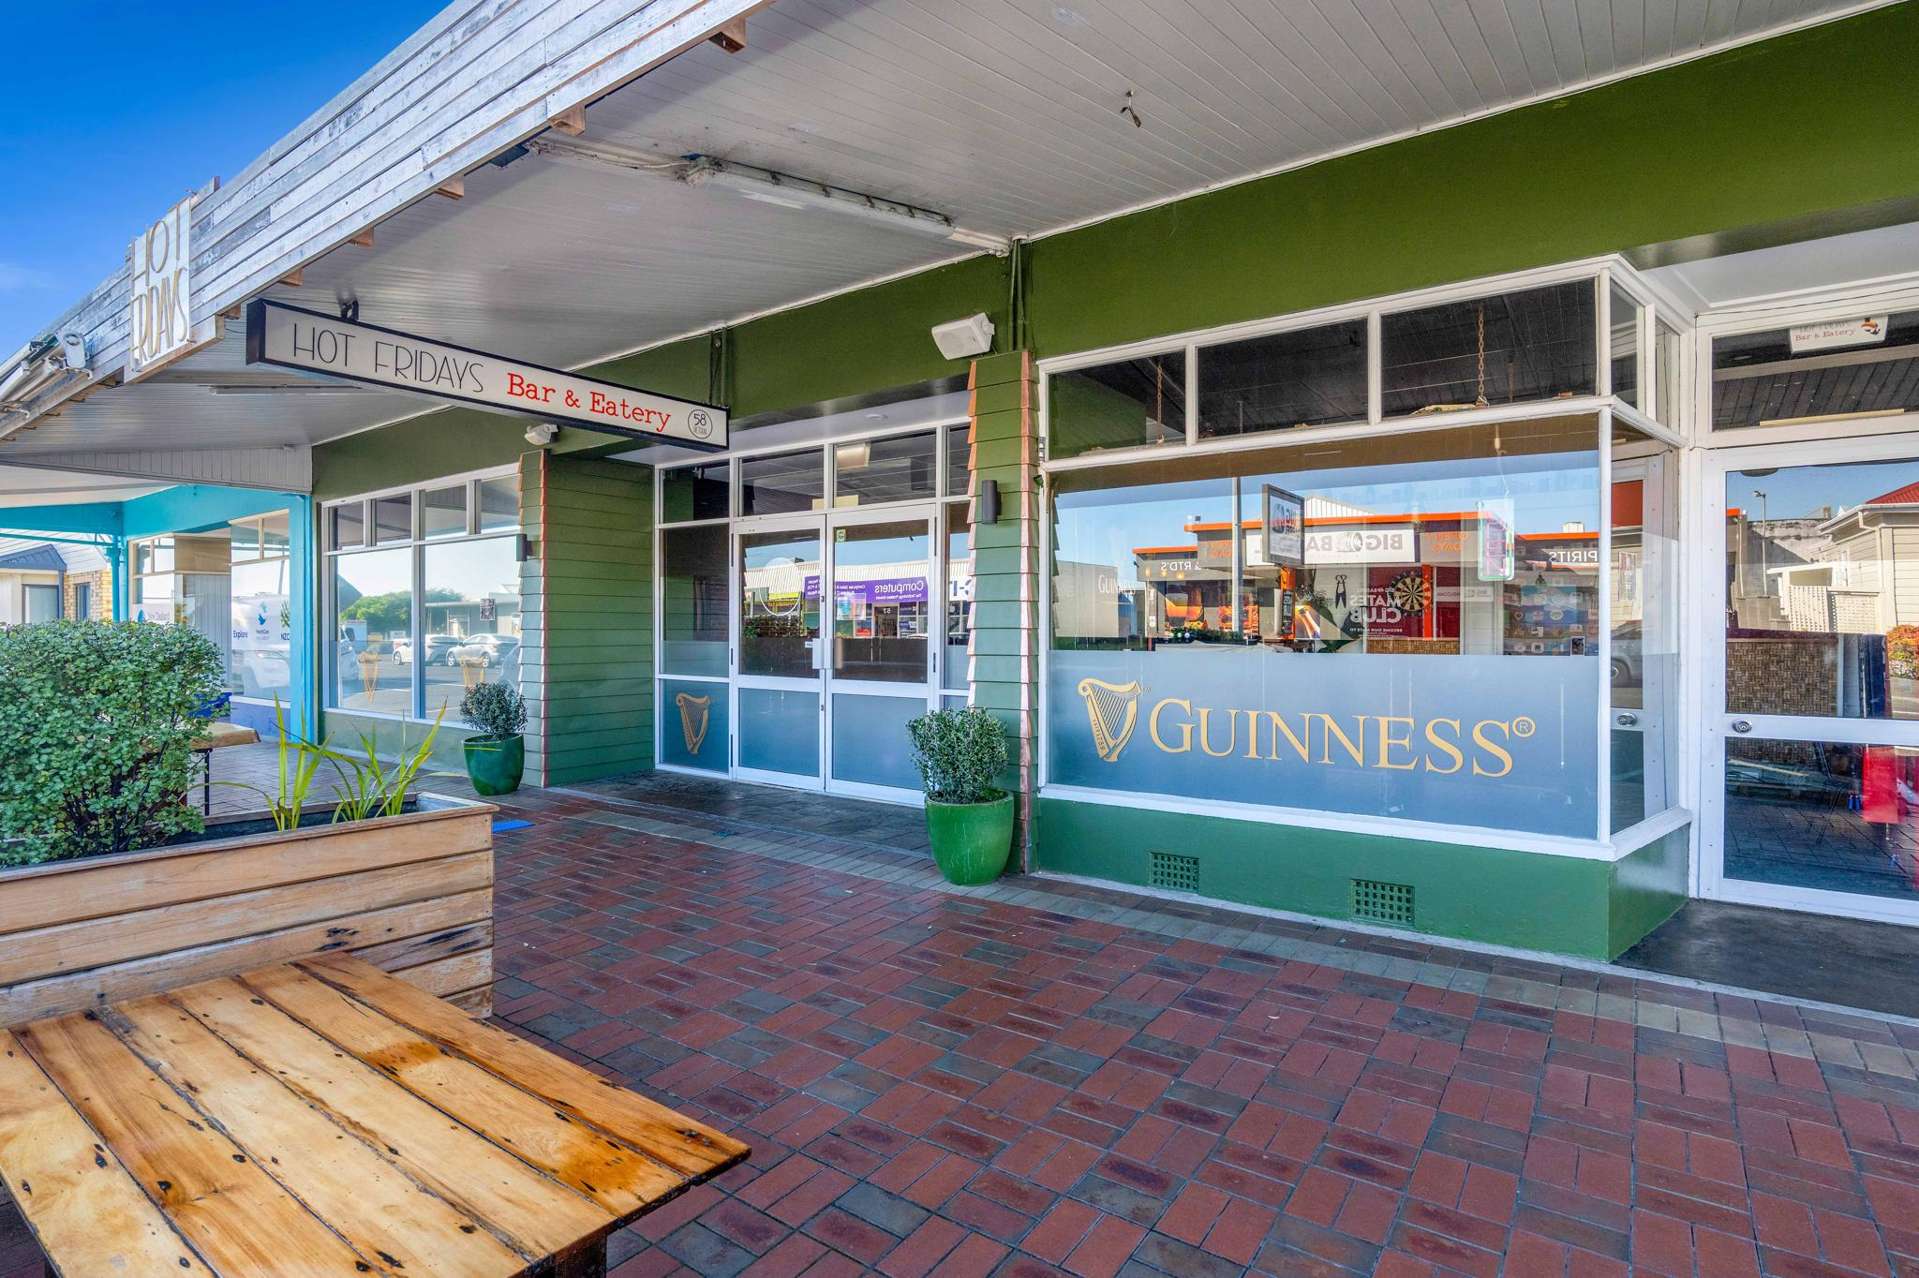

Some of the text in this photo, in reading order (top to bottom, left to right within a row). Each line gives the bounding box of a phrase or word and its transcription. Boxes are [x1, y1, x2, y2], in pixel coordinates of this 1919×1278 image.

[293, 323, 671, 433] HOT FRIDAYS Bar & Eatery
[693, 413, 707, 426] 58
